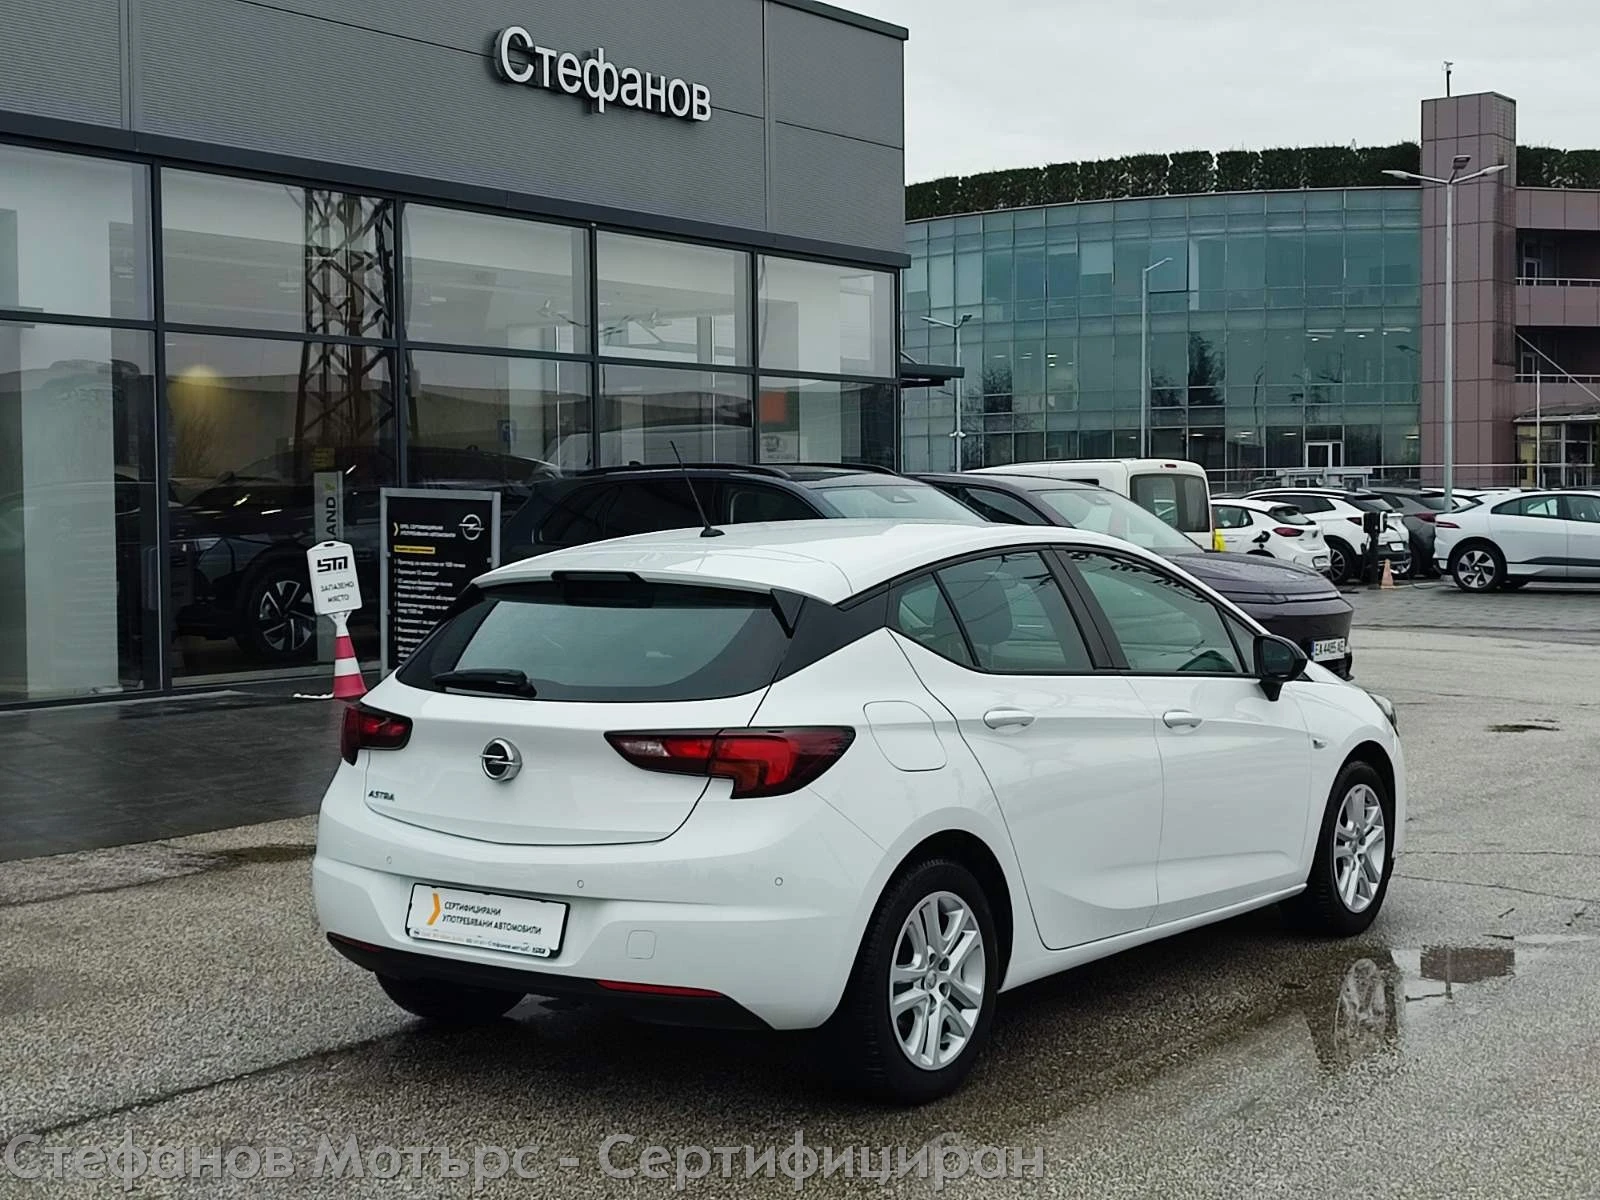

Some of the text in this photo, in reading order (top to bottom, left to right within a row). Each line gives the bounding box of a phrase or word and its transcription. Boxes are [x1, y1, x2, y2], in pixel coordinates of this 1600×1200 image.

[498, 25, 712, 122] Стефанов
[326, 496, 337, 541] AND
[320, 581, 355, 592] ЗАПАЗЕНО
[368, 790, 395, 802] ASTRA
[444, 901, 502, 916] СЕРТИФИЦИРАНИ
[442, 914, 542, 934] УПОТРЕБЯВАНИ АВТОМОБИЛИ
